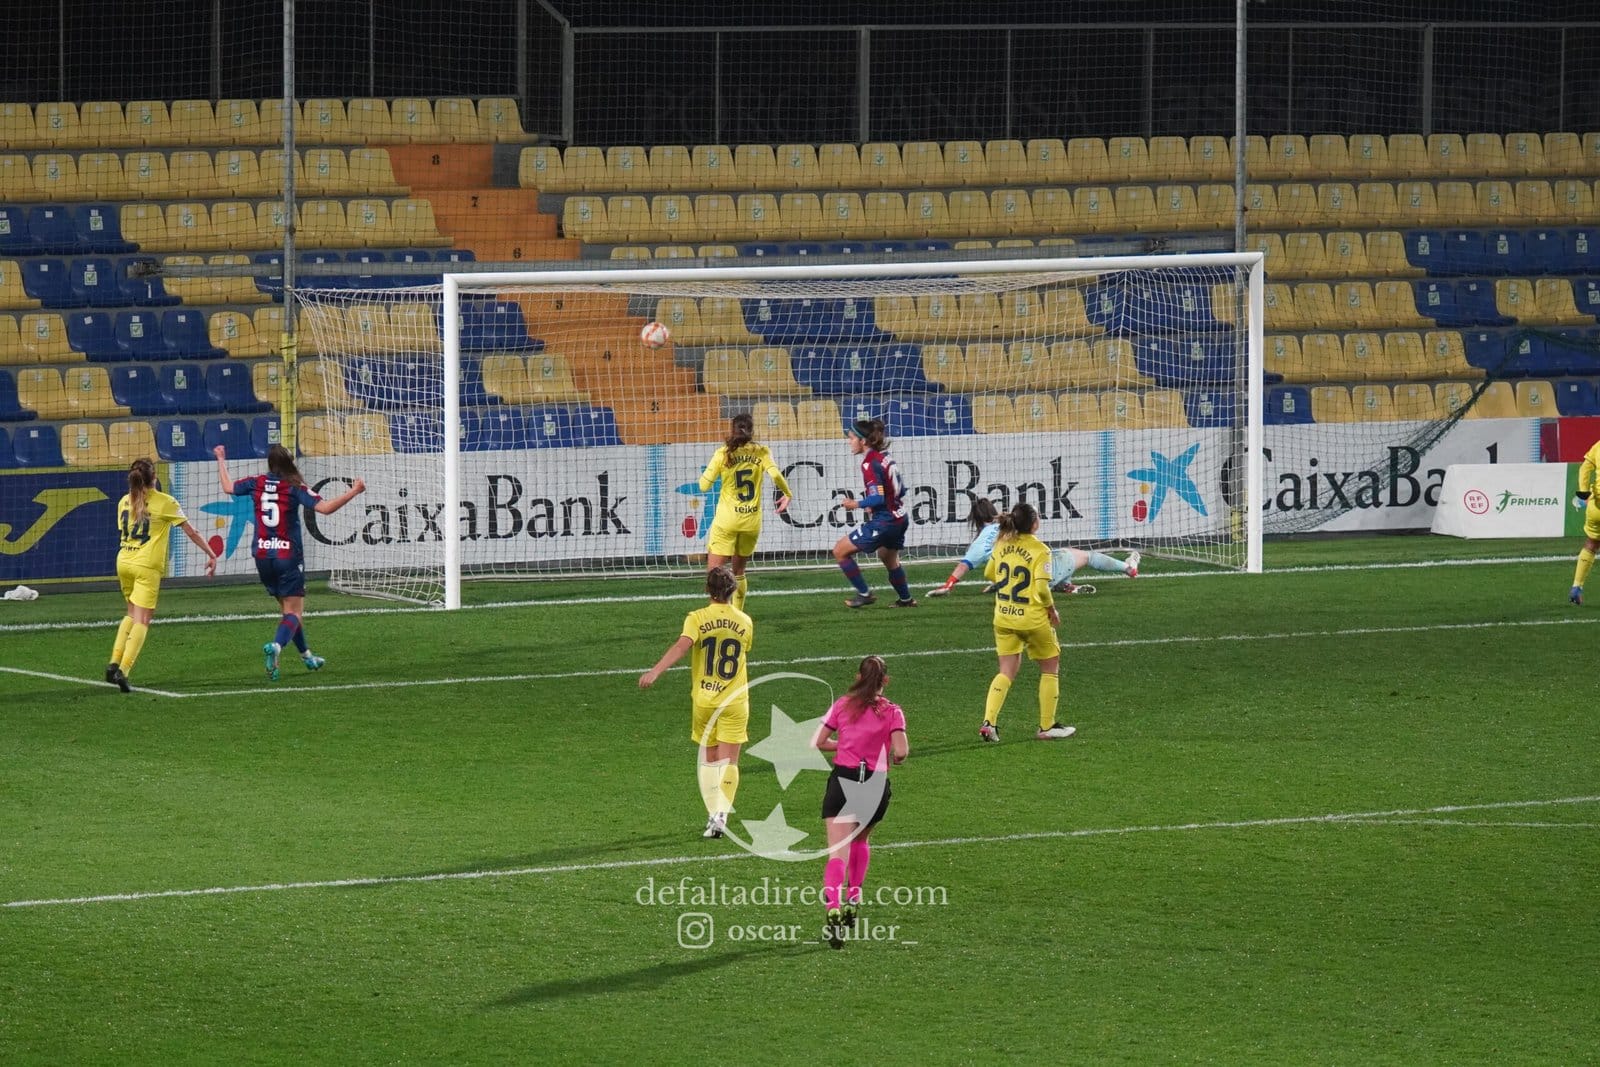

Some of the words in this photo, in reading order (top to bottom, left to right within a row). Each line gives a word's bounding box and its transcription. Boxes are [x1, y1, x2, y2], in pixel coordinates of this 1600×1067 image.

[471, 195, 479, 208] 7
[735, 469, 755, 503] 5
[1510, 497, 1559, 506] PRIMERA
[261, 492, 280, 527] 5
[303, 470, 632, 546] CaixaBank
[120, 509, 151, 546] 14
[258, 537, 290, 550] teika
[1000, 545, 1015, 557] LARA
[1015, 546, 1033, 564] MATA
[996, 562, 1031, 604] 22
[699, 619, 746, 637] SOLDEVILA
[701, 636, 741, 680] 18
